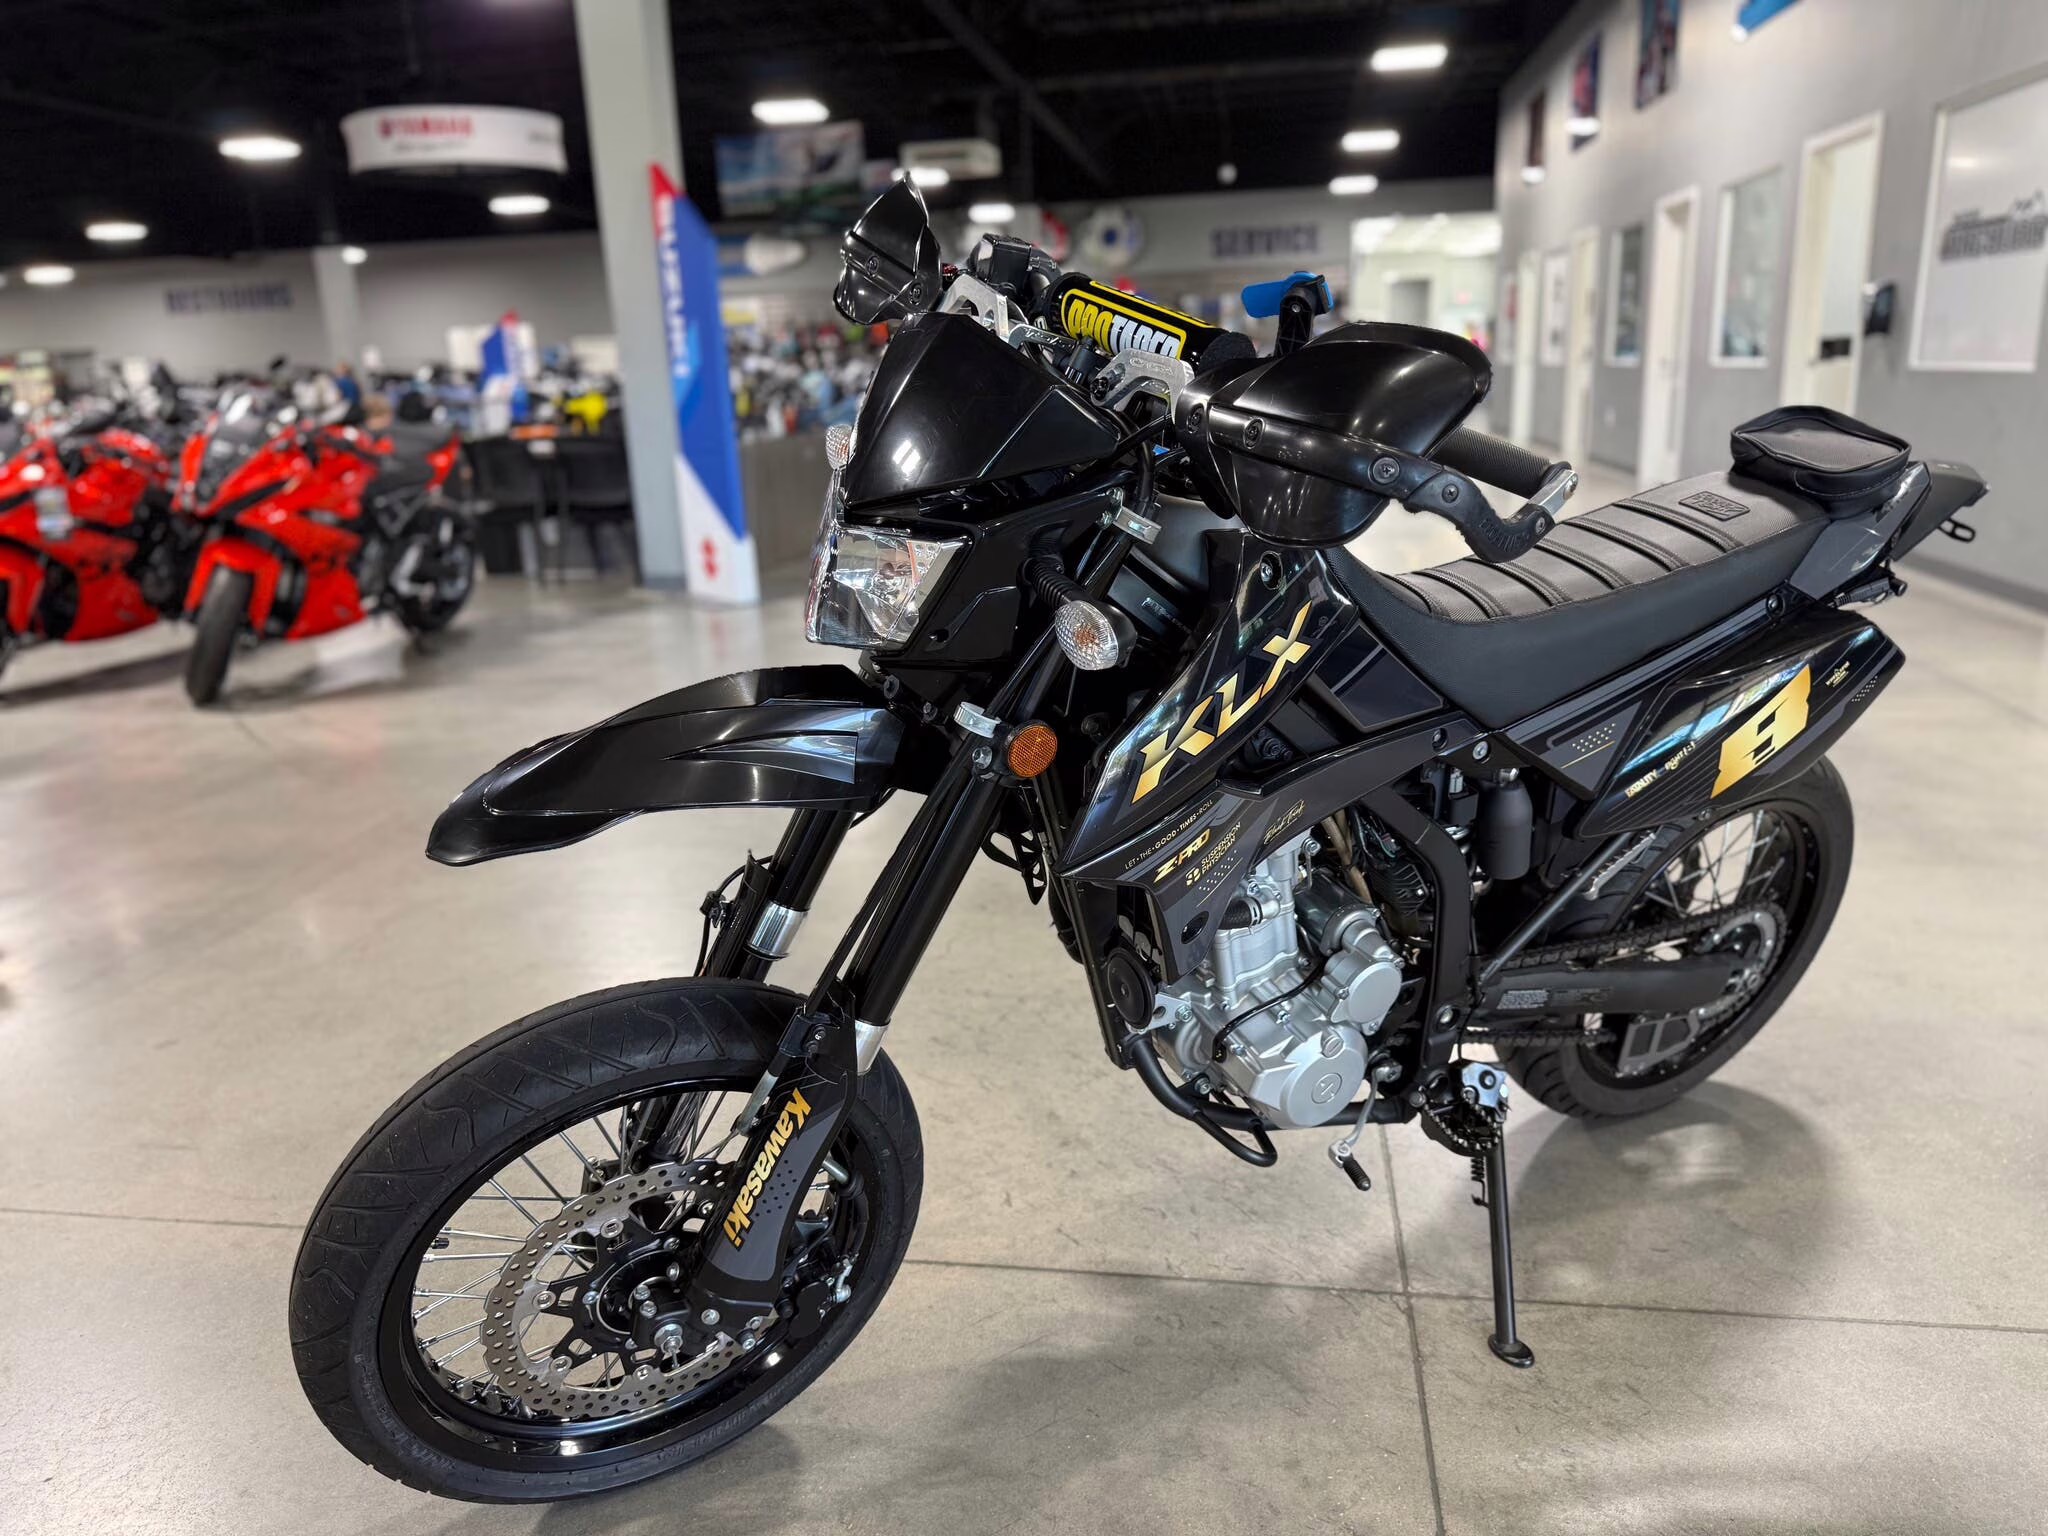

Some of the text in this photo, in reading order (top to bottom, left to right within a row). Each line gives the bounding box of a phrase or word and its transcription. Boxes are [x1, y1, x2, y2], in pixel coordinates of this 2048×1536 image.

[1131, 600, 1311, 806] KLX
[1124, 857, 1136, 870] LET
[1139, 847, 1152, 861] THE
[1154, 829, 1177, 850] GOOD
[1179, 812, 1198, 832] TIMES
[1201, 821, 1241, 867] SUSPENSION
[1201, 835, 1236, 875] PHYSICIAN
[723, 1087, 812, 1247] Kawasaki
